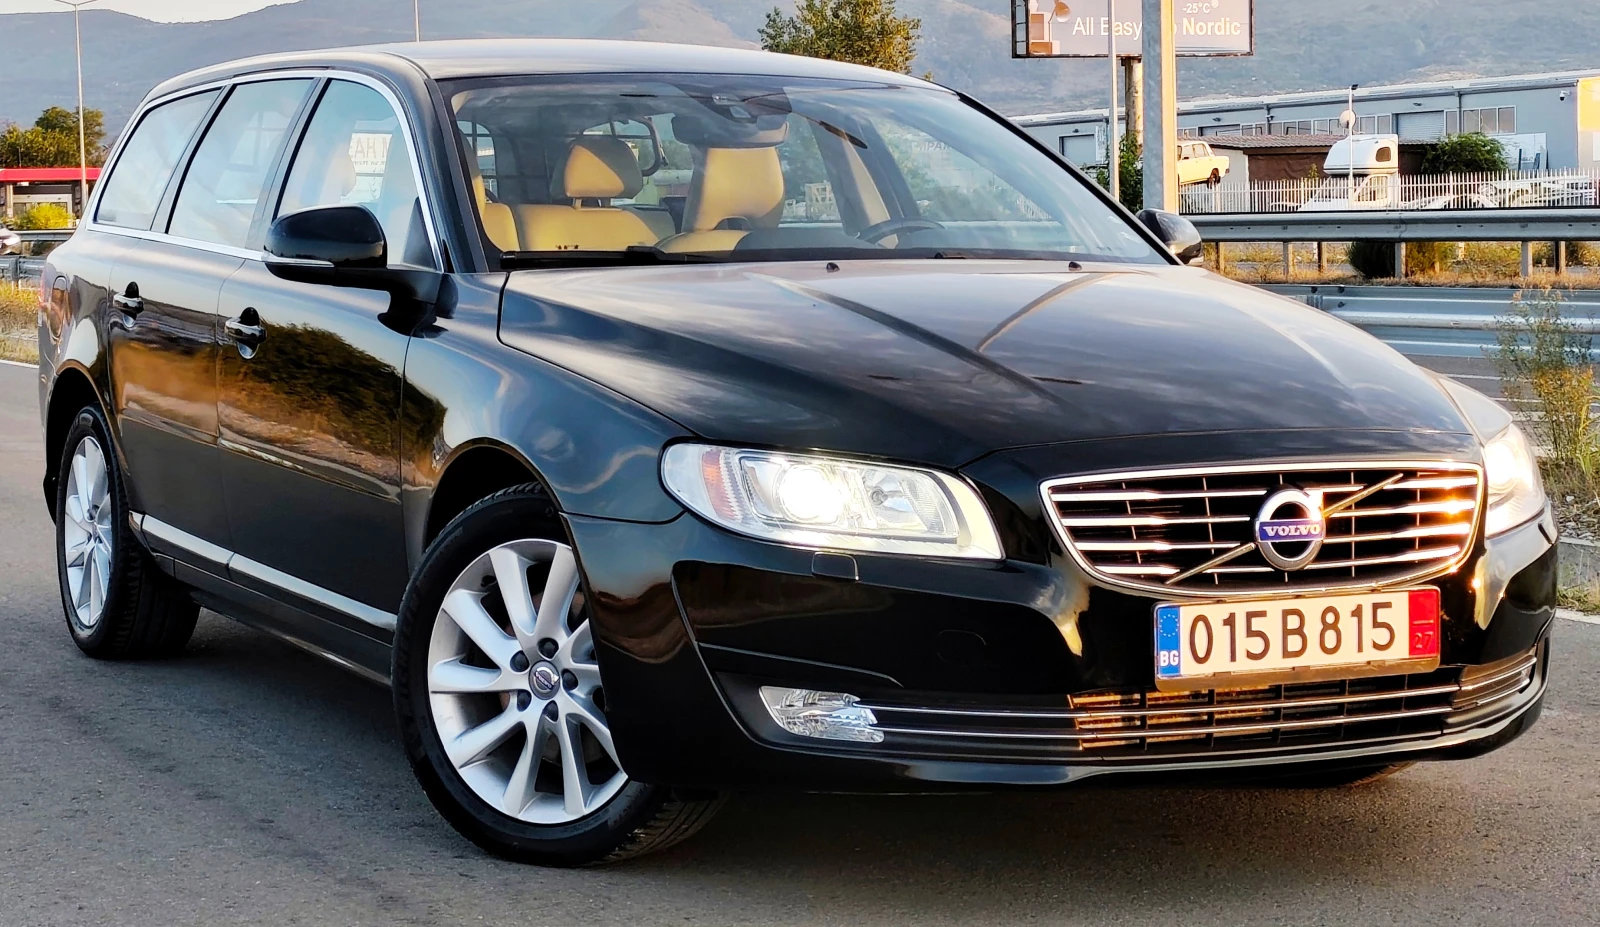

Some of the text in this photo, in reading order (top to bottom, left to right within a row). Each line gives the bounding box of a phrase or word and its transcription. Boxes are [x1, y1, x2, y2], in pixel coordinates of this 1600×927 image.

[1072, 17, 1094, 36] All
[1101, 17, 1142, 40] Easy
[1182, 17, 1241, 36] Nordic
[1263, 524, 1320, 537] VOLVO
[1160, 650, 1179, 667] BG
